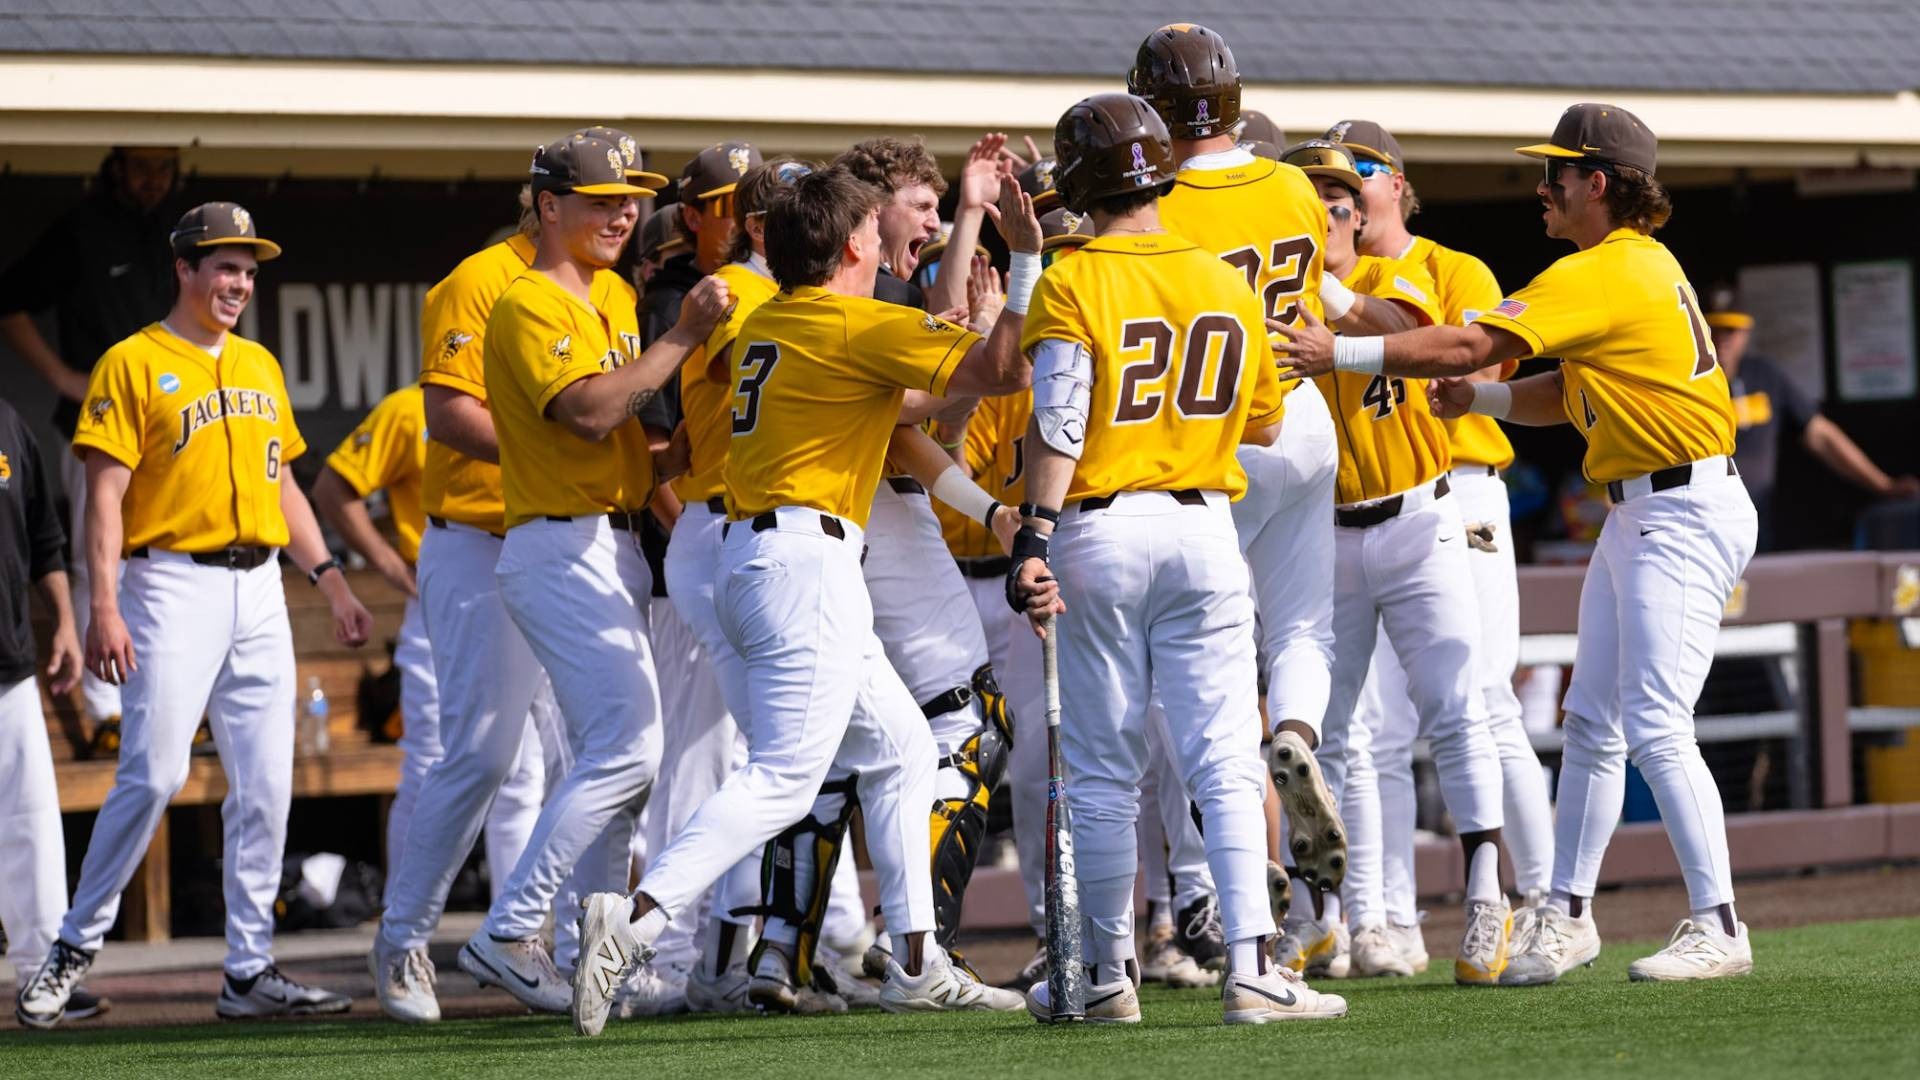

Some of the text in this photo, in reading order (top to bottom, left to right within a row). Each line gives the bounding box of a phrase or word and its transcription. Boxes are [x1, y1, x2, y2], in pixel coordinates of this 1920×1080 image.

[731, 341, 781, 438] 3
[1113, 314, 1245, 424] 20
[172, 387, 277, 457] JACKETS
[266, 437, 281, 482] 6
